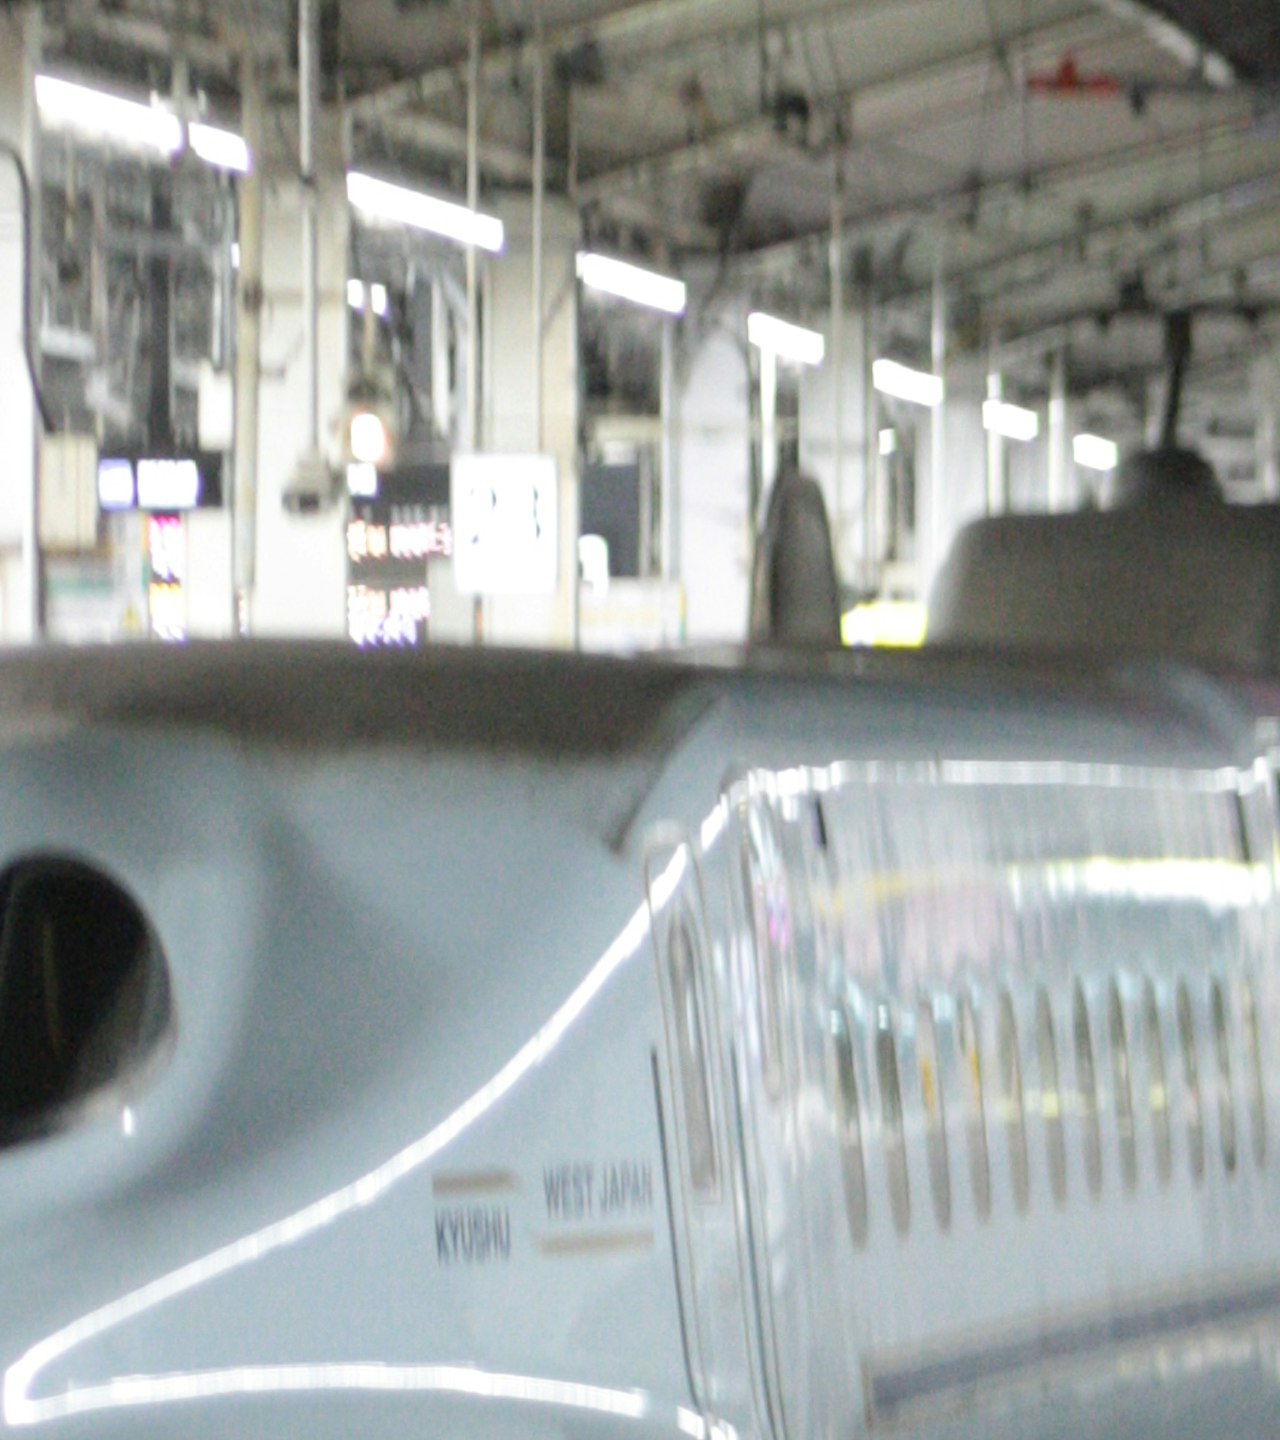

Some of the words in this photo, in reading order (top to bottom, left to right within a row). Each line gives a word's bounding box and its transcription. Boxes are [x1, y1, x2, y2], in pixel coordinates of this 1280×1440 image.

[542, 1162, 594, 1219] WEST
[599, 1160, 653, 1216] JAPAN
[434, 1206, 511, 1264] KYUSHU
